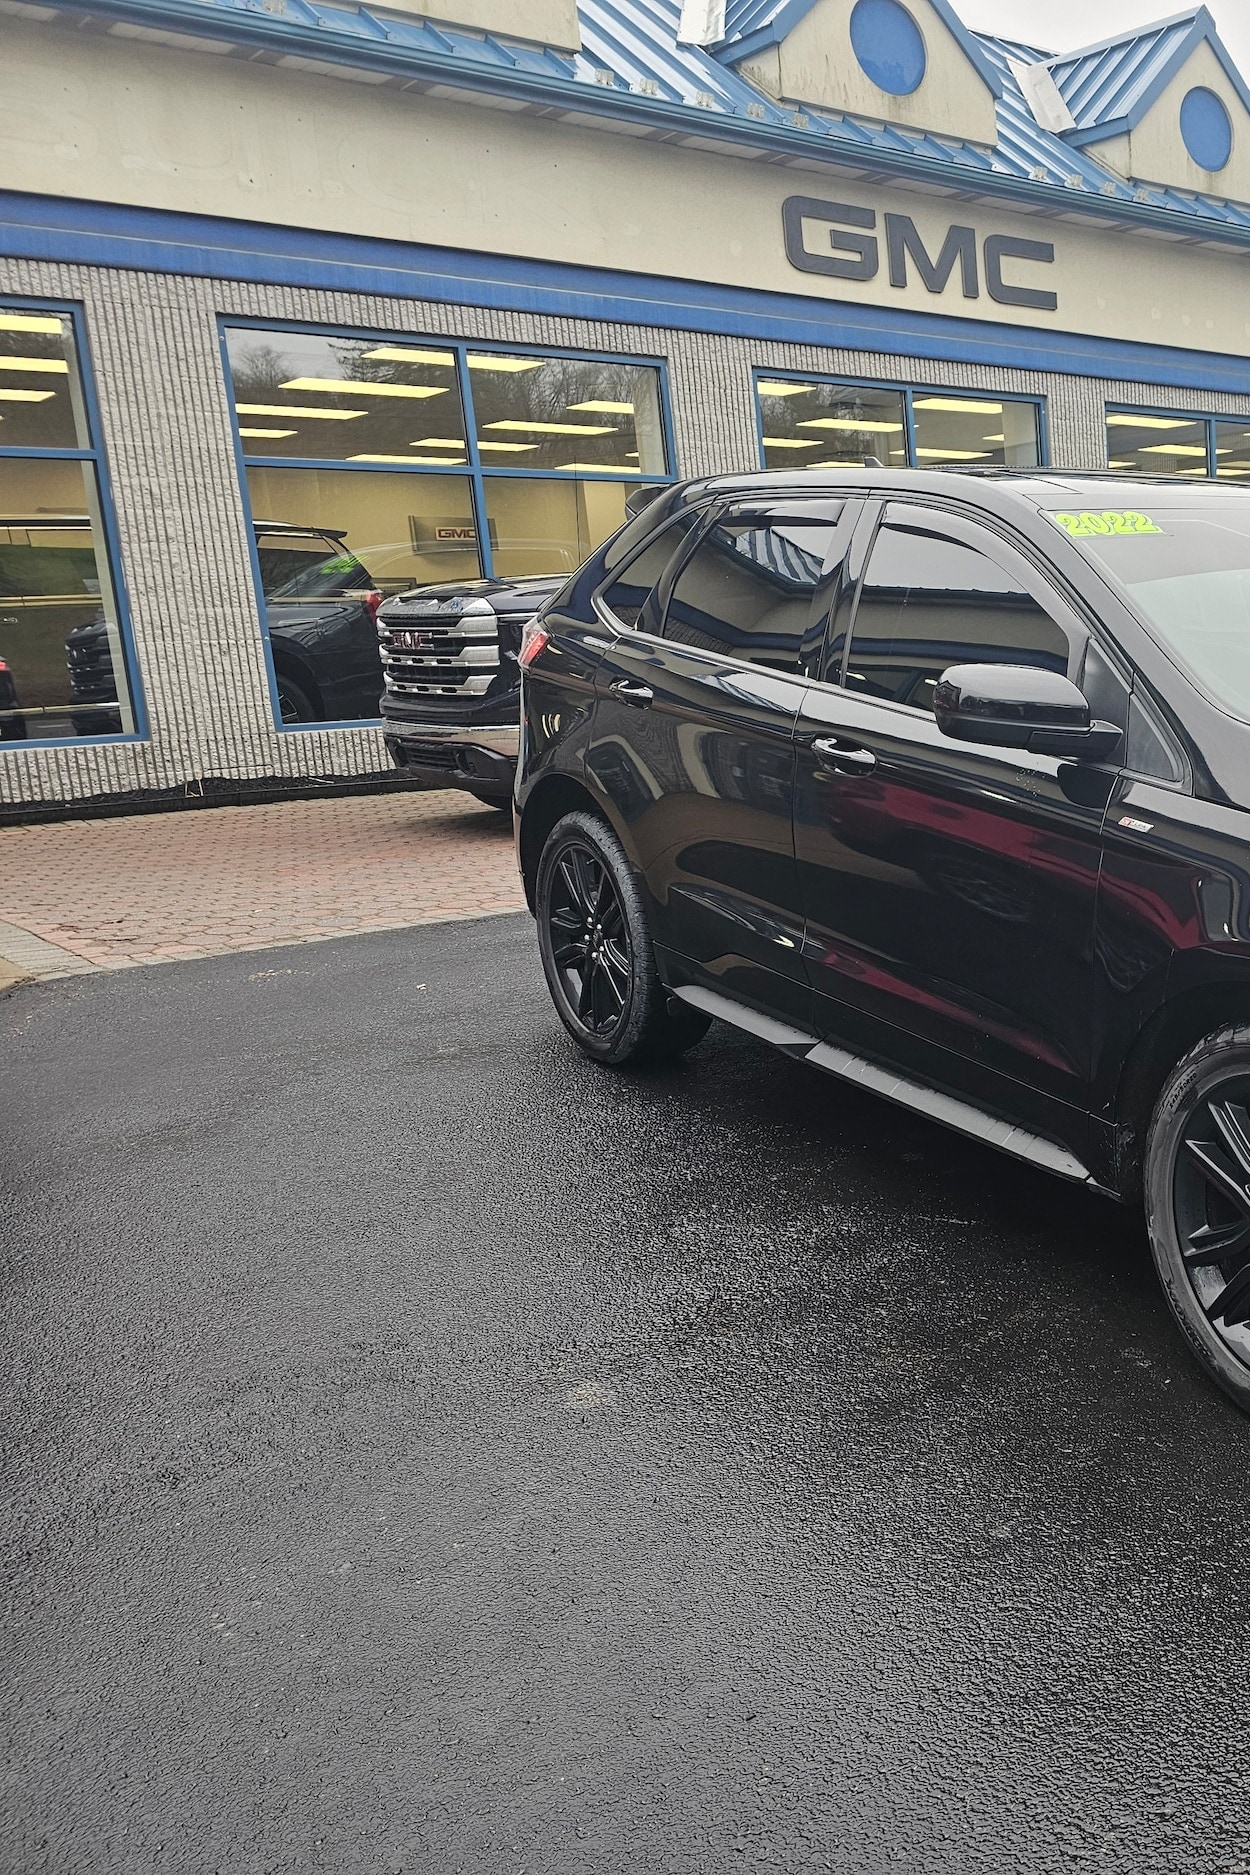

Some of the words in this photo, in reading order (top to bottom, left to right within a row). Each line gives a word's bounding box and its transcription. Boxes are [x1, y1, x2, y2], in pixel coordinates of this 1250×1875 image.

[782, 195, 1057, 310] GMC
[438, 528, 476, 539] GMC
[1056, 511, 1165, 538] 2022
[392, 631, 434, 650] GMC
